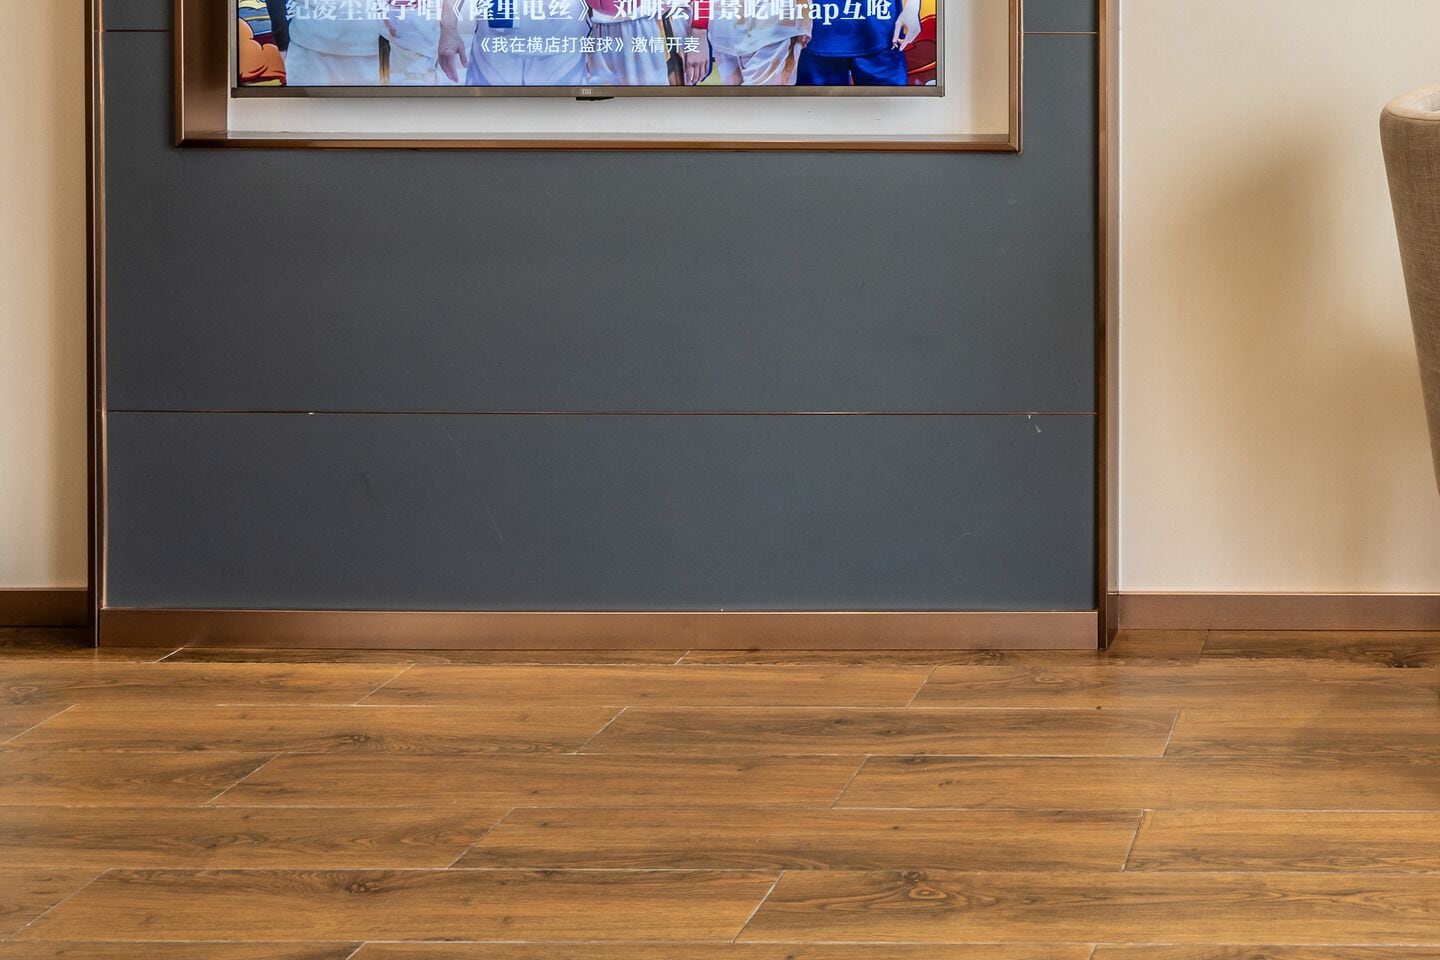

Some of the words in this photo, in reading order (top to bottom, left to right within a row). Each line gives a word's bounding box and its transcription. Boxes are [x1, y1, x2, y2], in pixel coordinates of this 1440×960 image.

[480, 36, 701, 54] 《我在横店打篮球》激情开麦
